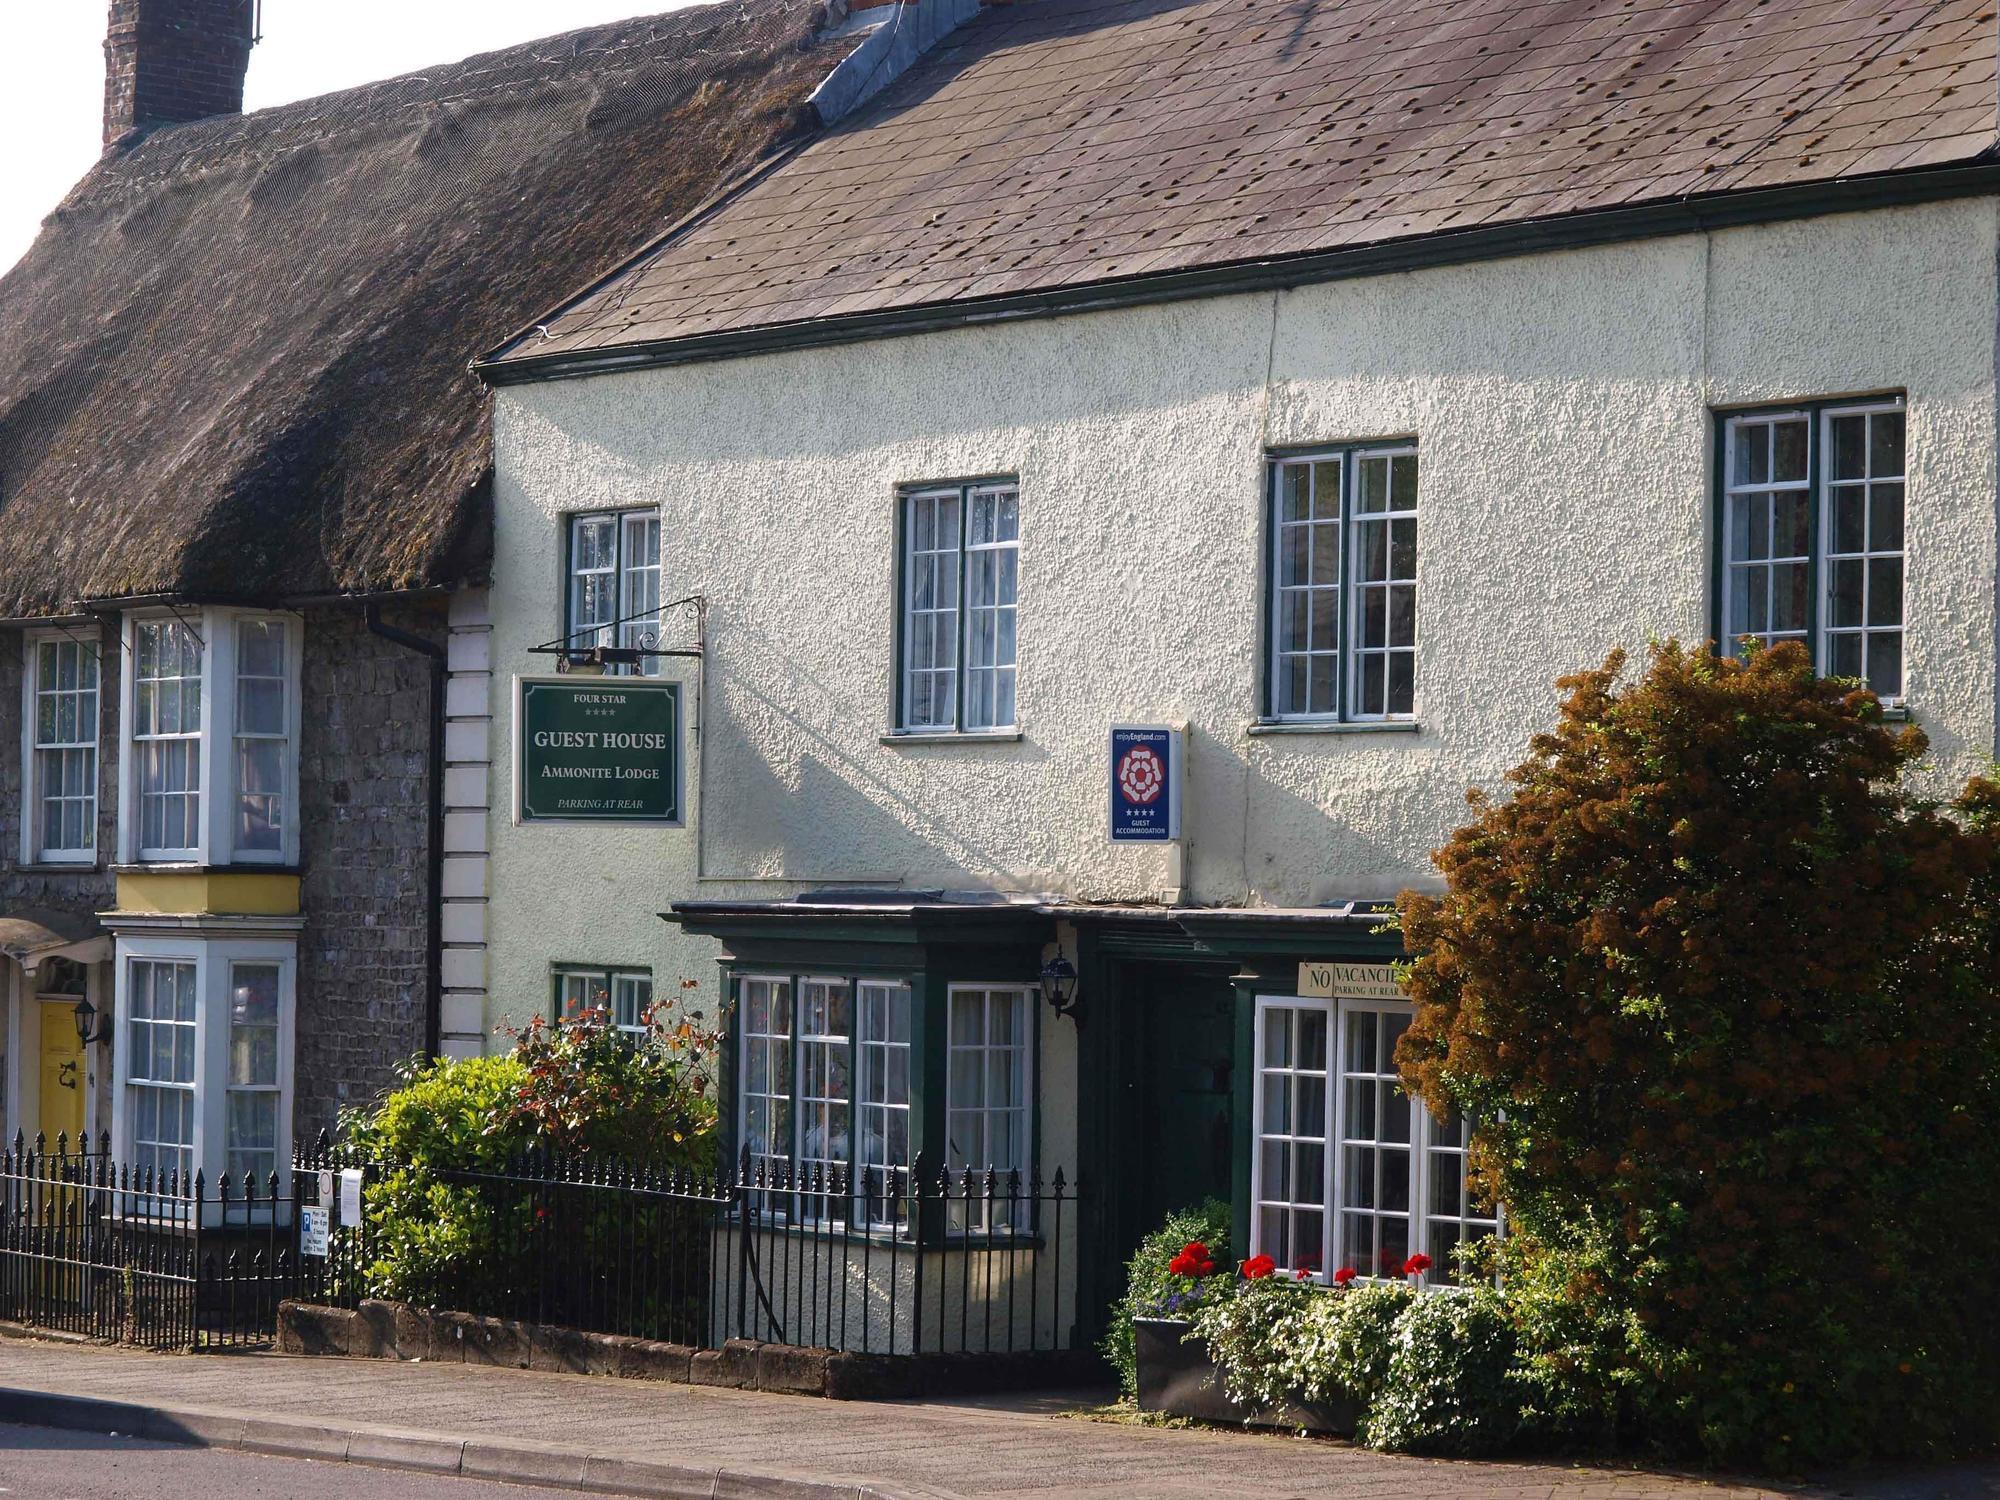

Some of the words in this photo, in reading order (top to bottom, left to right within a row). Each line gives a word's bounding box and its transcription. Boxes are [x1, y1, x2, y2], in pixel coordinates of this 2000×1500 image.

[573, 694, 600, 703] FOUR
[601, 695, 627, 704] STAR
[534, 731, 598, 748] GUEST
[603, 732, 666, 749] HOUSE
[1116, 733, 1167, 742] enjoyEngland.com
[541, 765, 612, 779] AMMONITE
[615, 766, 660, 780] LODGE
[558, 799, 601, 809] PARKING
[603, 799, 617, 809] AT
[617, 800, 643, 809] REAR
[1131, 819, 1150, 827] GUEST
[1310, 969, 1331, 989] NO
[1336, 967, 1398, 983] VACANCIE
[1335, 986, 1366, 995] PARKING
[1369, 987, 1377, 995] AT
[1380, 987, 1399, 996] REAR
[303, 1214, 310, 1230] P
